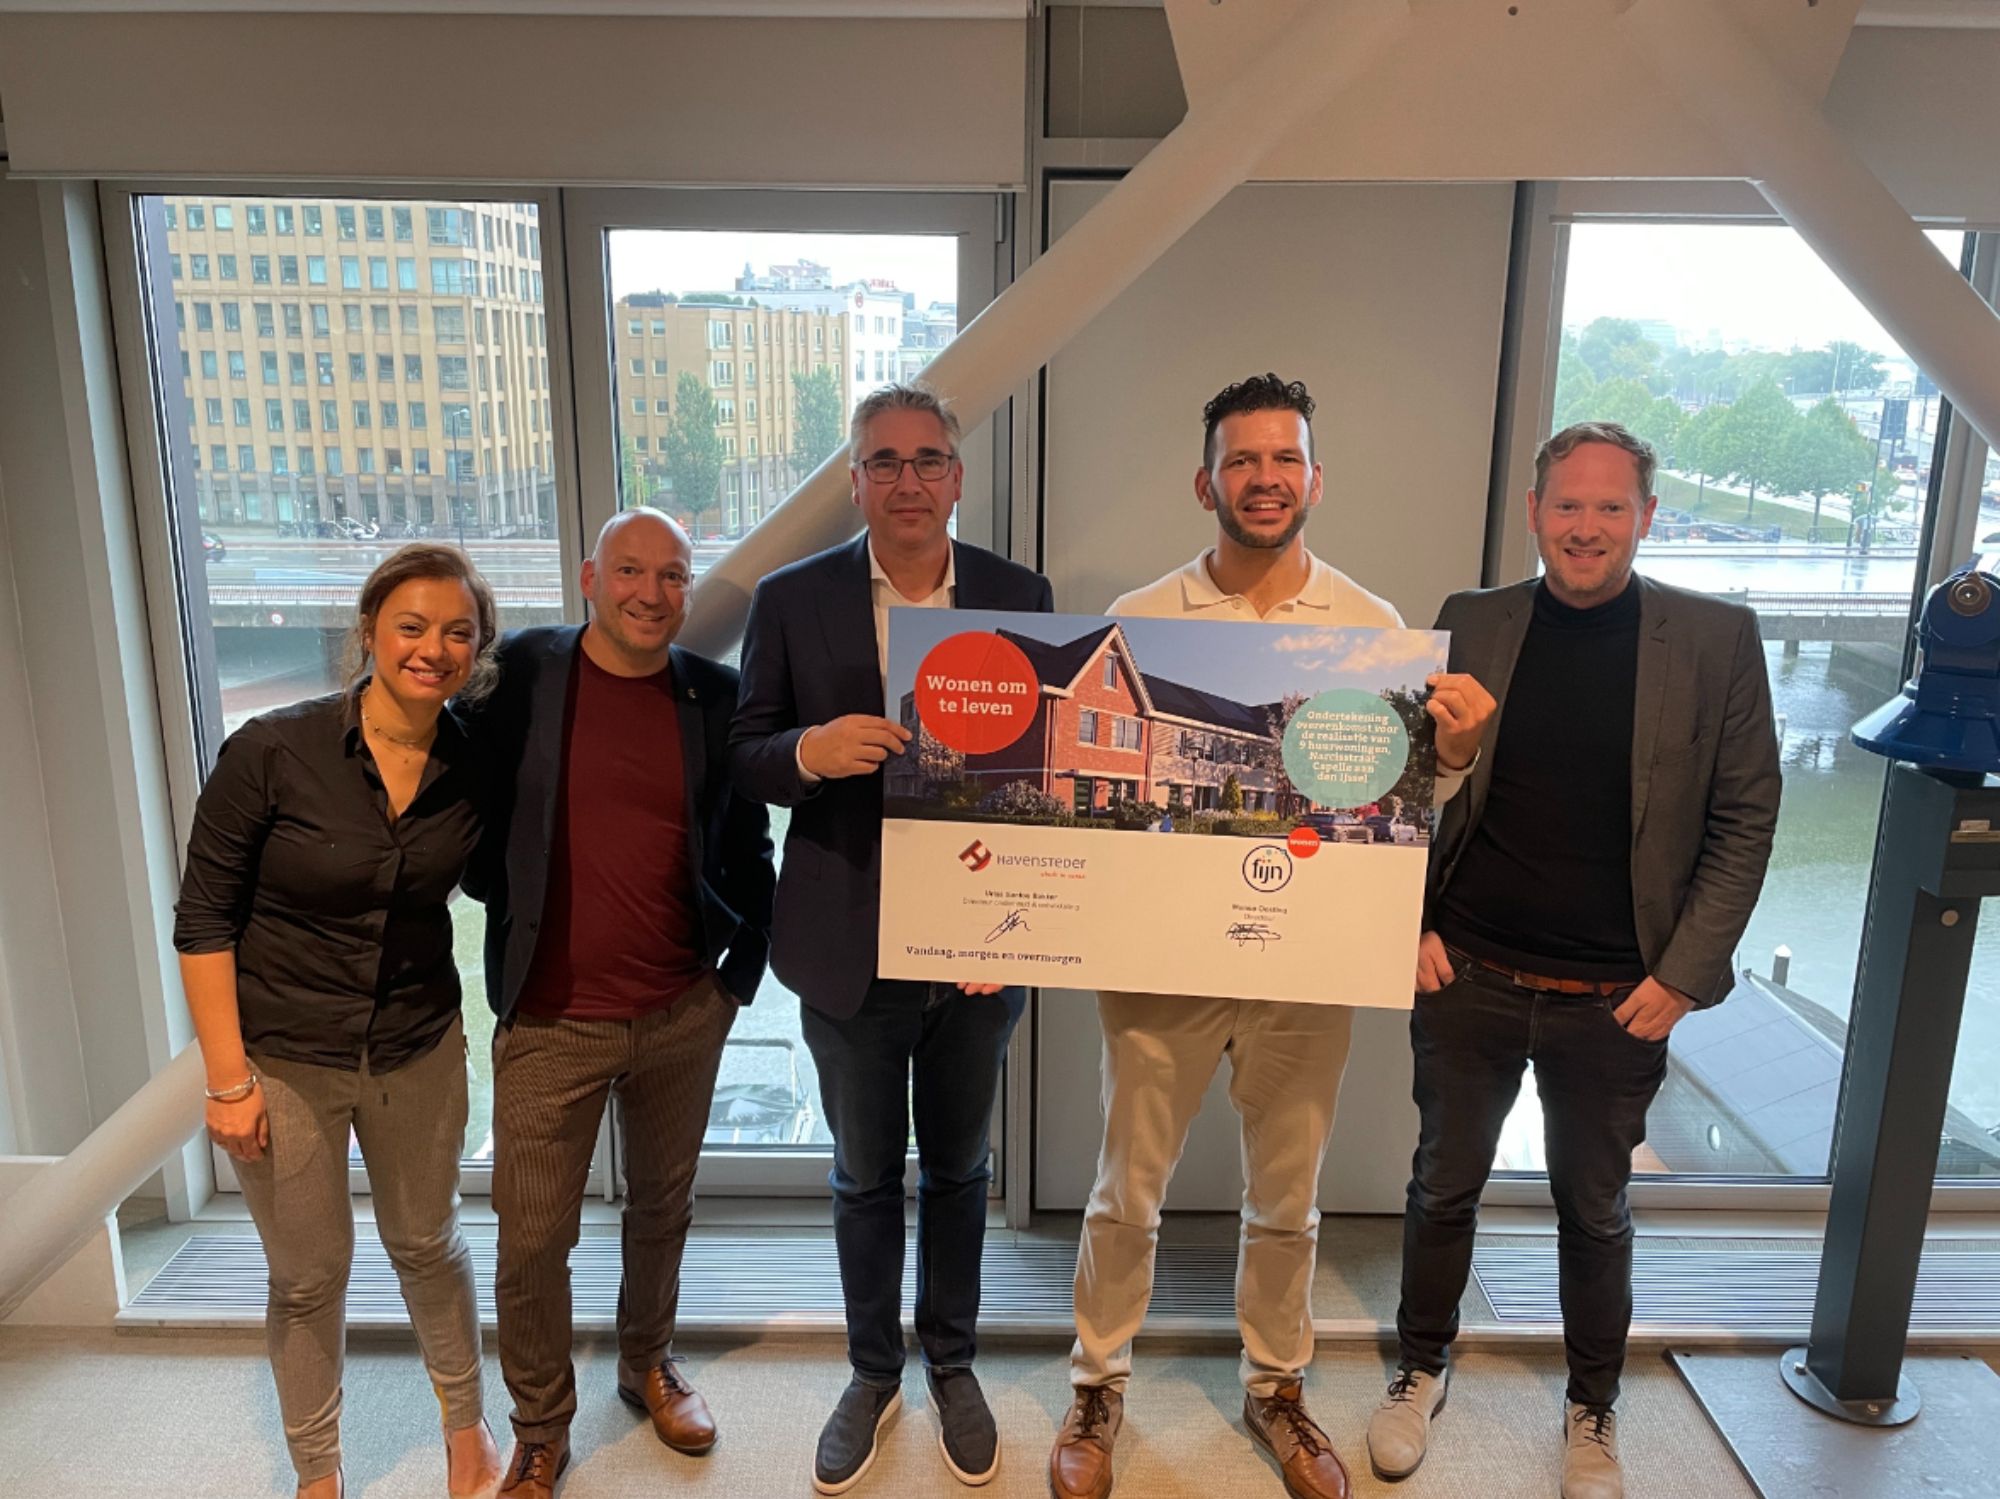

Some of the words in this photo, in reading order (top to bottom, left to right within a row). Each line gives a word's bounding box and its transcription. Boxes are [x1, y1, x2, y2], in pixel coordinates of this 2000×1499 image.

[926, 675, 992, 693] Wonen
[997, 681, 1027, 695] om
[938, 698, 958, 713] te
[962, 697, 1013, 716] leven
[1306, 711, 1389, 725] Ondertekening
[1296, 721, 1371, 733] overeenkomst
[1374, 725, 1398, 734] voor
[1301, 730, 1314, 739] de
[1371, 736, 1391, 744] van
[1308, 740, 1391, 755] huurwoningen,
[1312, 761, 1352, 773] Capelle
[1252, 858, 1283, 884] fijn
[906, 945, 956, 960] Vandaag,
[957, 949, 999, 961] morgen
[1001, 952, 1016, 961] en
[1017, 952, 1083, 966] overmorgen
